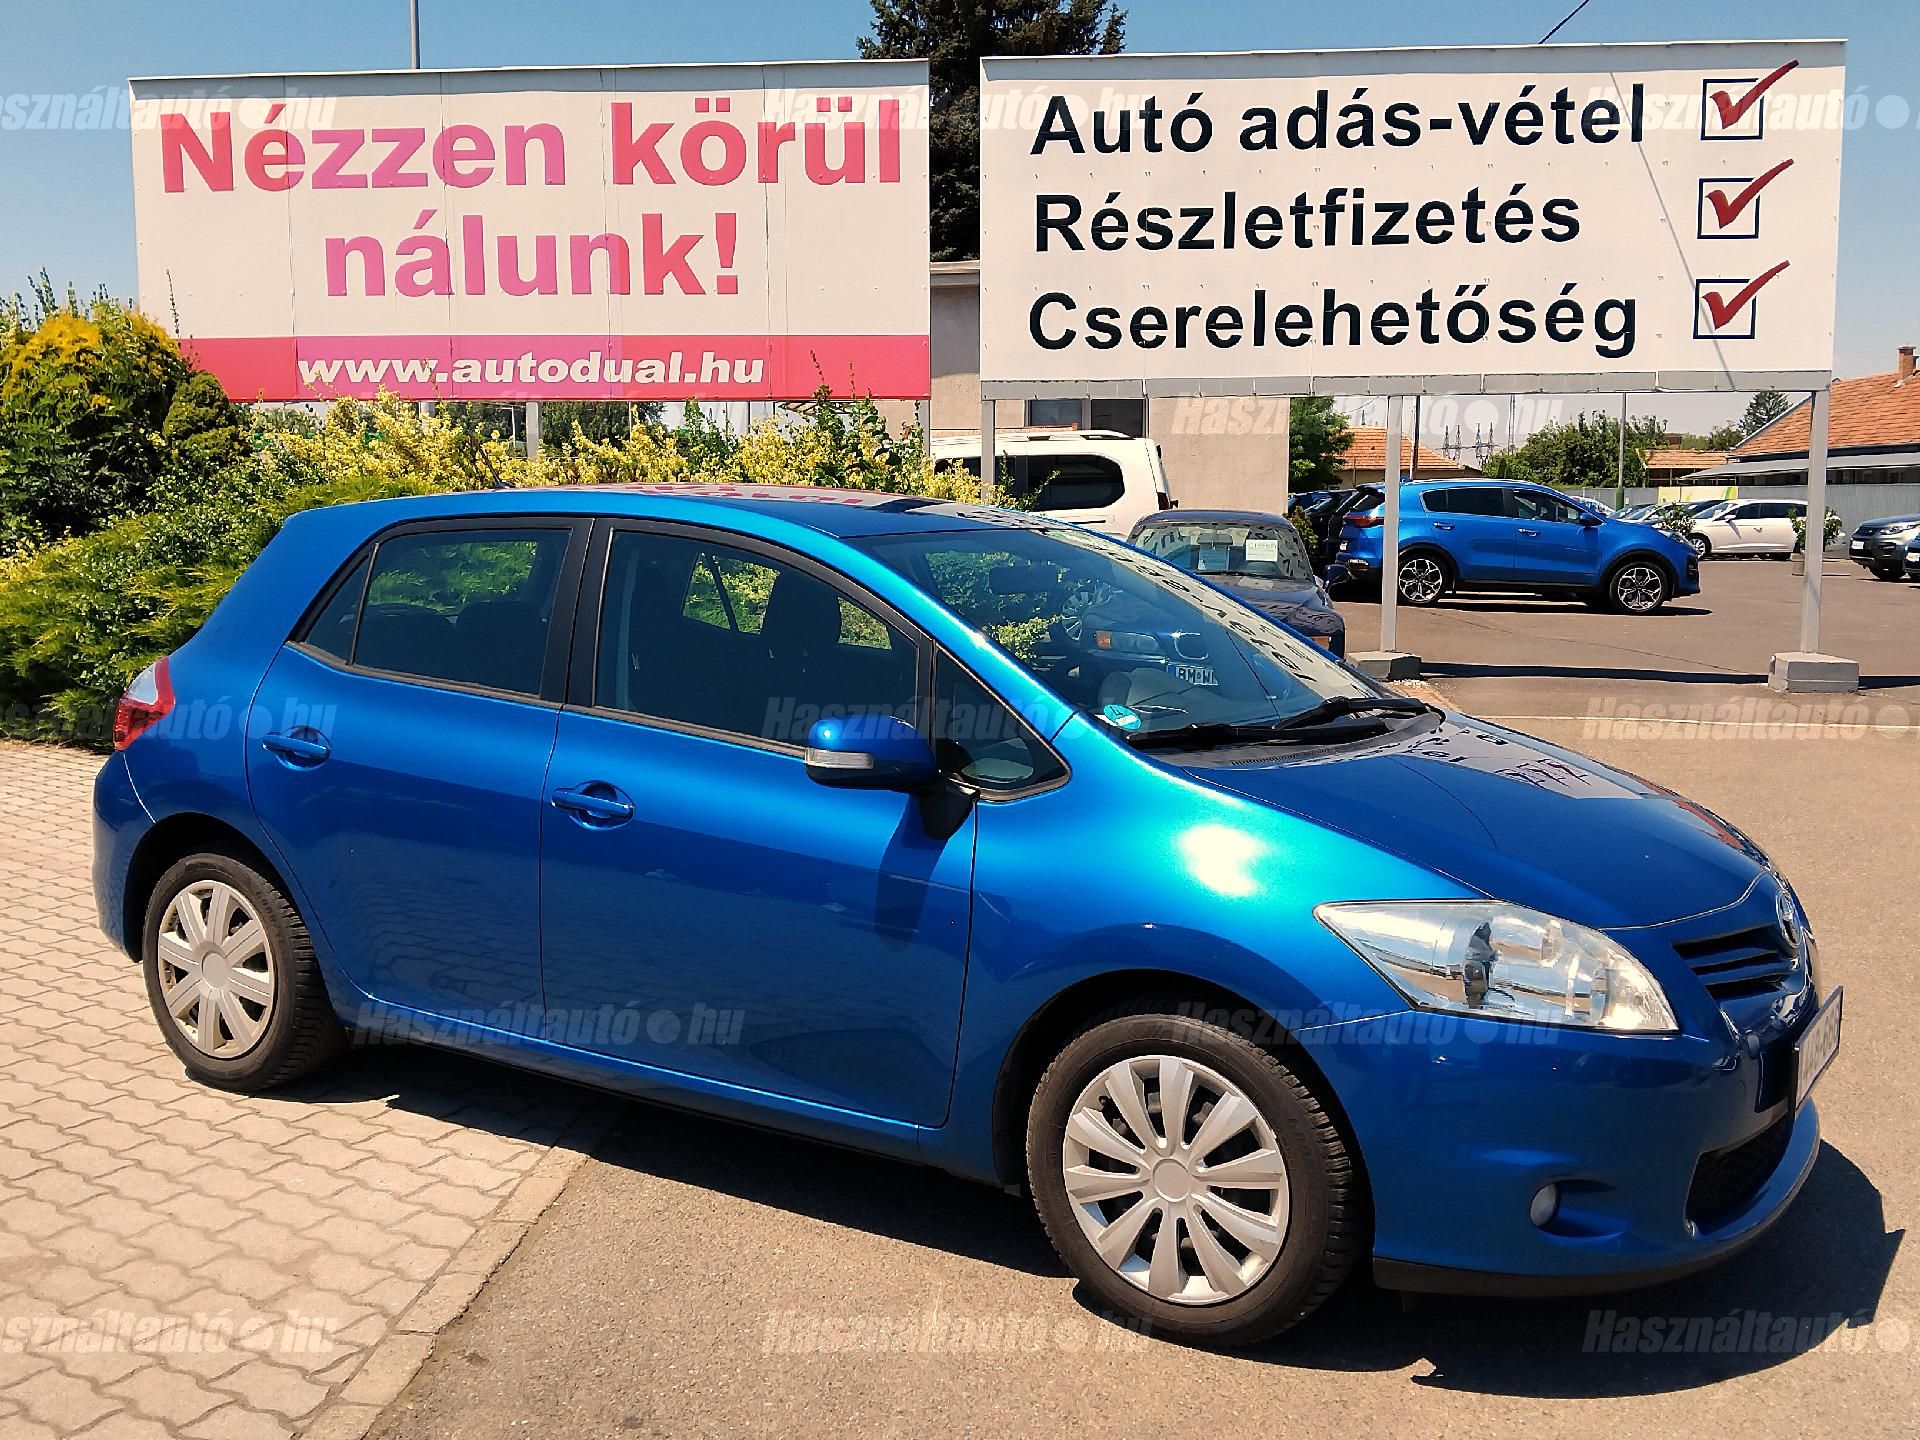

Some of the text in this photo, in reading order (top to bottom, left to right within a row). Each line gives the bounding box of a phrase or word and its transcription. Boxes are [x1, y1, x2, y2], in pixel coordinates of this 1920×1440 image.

[160, 97, 901, 193] Nézzen körül
[1030, 84, 1643, 156] Autó adás-vétel
[325, 209, 737, 297] nálunk!
[1037, 183, 1579, 252] Részletfizetés
[1030, 283, 1635, 358] Cserelehetőség
[297, 351, 764, 384] www.autodual.hu
